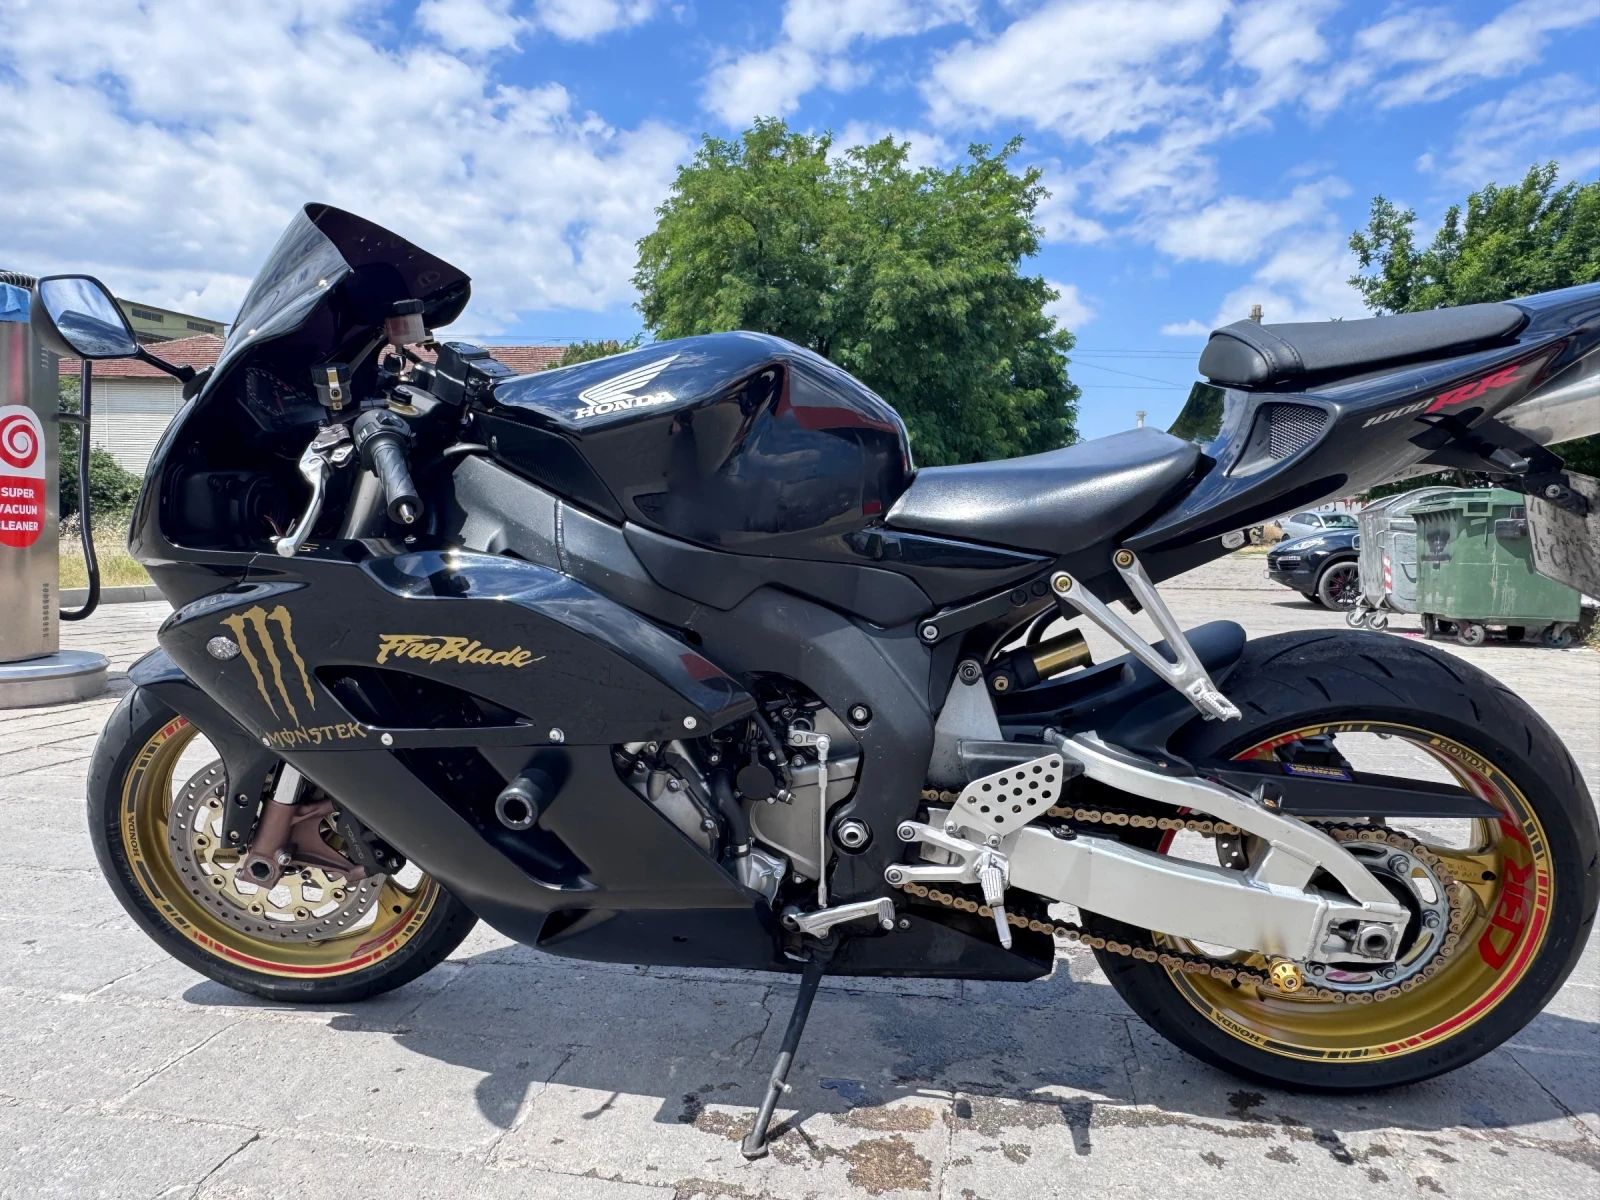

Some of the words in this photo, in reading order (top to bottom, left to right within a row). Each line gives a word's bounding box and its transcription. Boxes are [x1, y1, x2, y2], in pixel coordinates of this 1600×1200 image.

[574, 391, 677, 420] HONDA
[1, 487, 34, 499] SUPER
[0, 521, 39, 531] LEANER
[376, 634, 546, 668] FireBlade
[1440, 742, 1488, 775] HONDA
[127, 815, 140, 857] HONDA
[1478, 855, 1535, 971] CBR
[1215, 1011, 1260, 1043] HONDA
